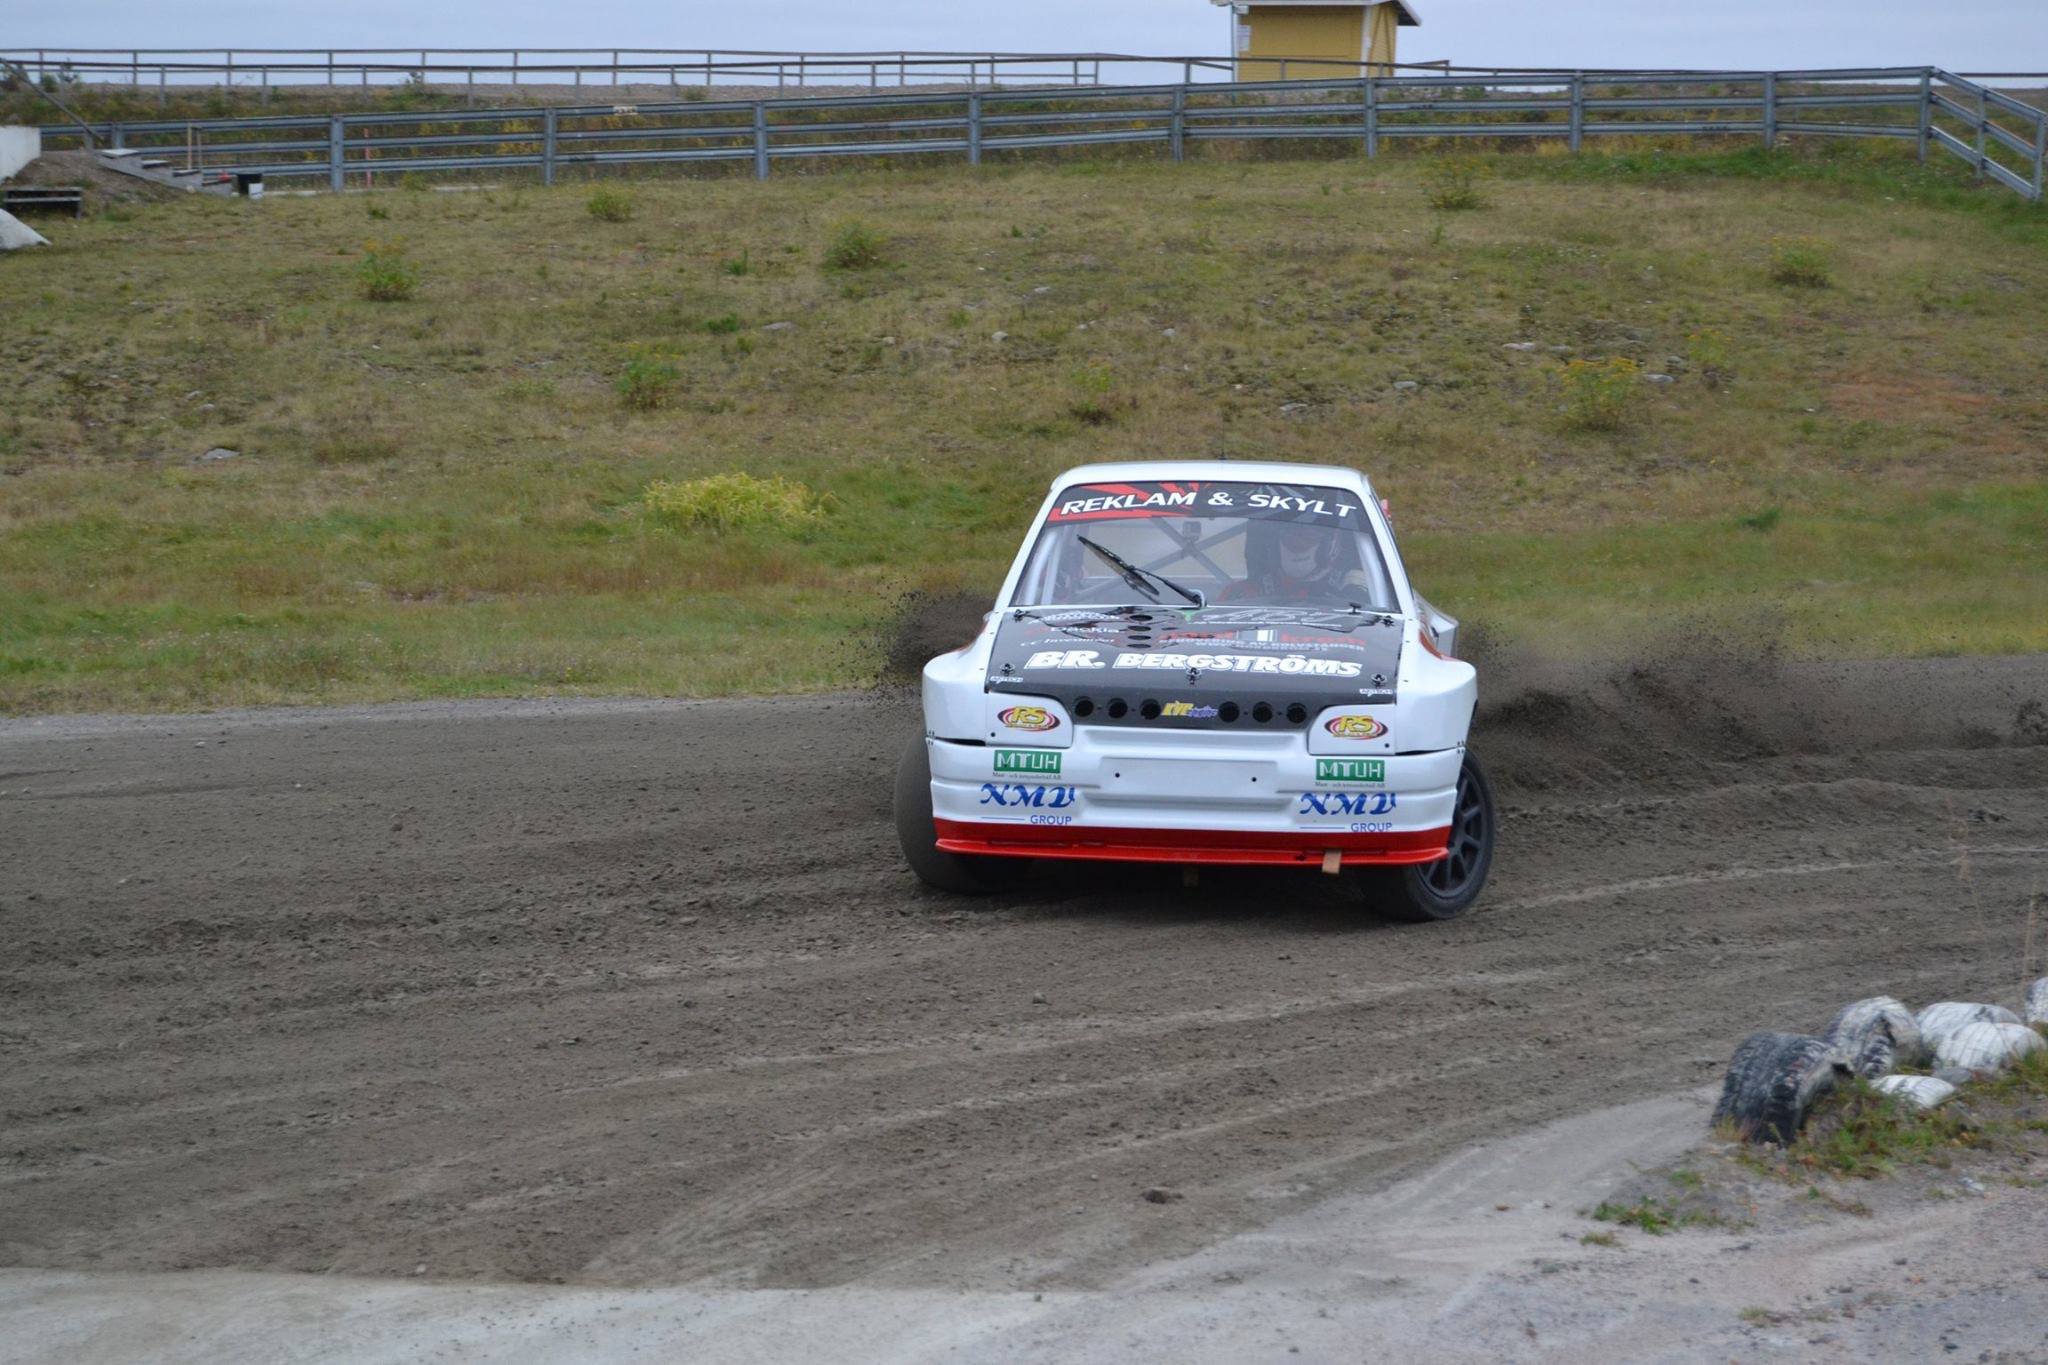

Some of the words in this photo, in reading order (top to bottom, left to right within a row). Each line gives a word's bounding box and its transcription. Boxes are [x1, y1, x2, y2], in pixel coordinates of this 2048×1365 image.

[1060, 492, 1197, 515] REKLAM
[1207, 491, 1233, 507] &
[1248, 494, 1357, 518] SKYLT
[1024, 650, 1106, 669] BR.
[1112, 653, 1363, 678] BERGSTRÖMS
[996, 753, 1058, 770] MTUH
[1319, 761, 1381, 778] MTUH
[1030, 815, 1072, 825] GROUP
[1350, 822, 1392, 832] GROUP
